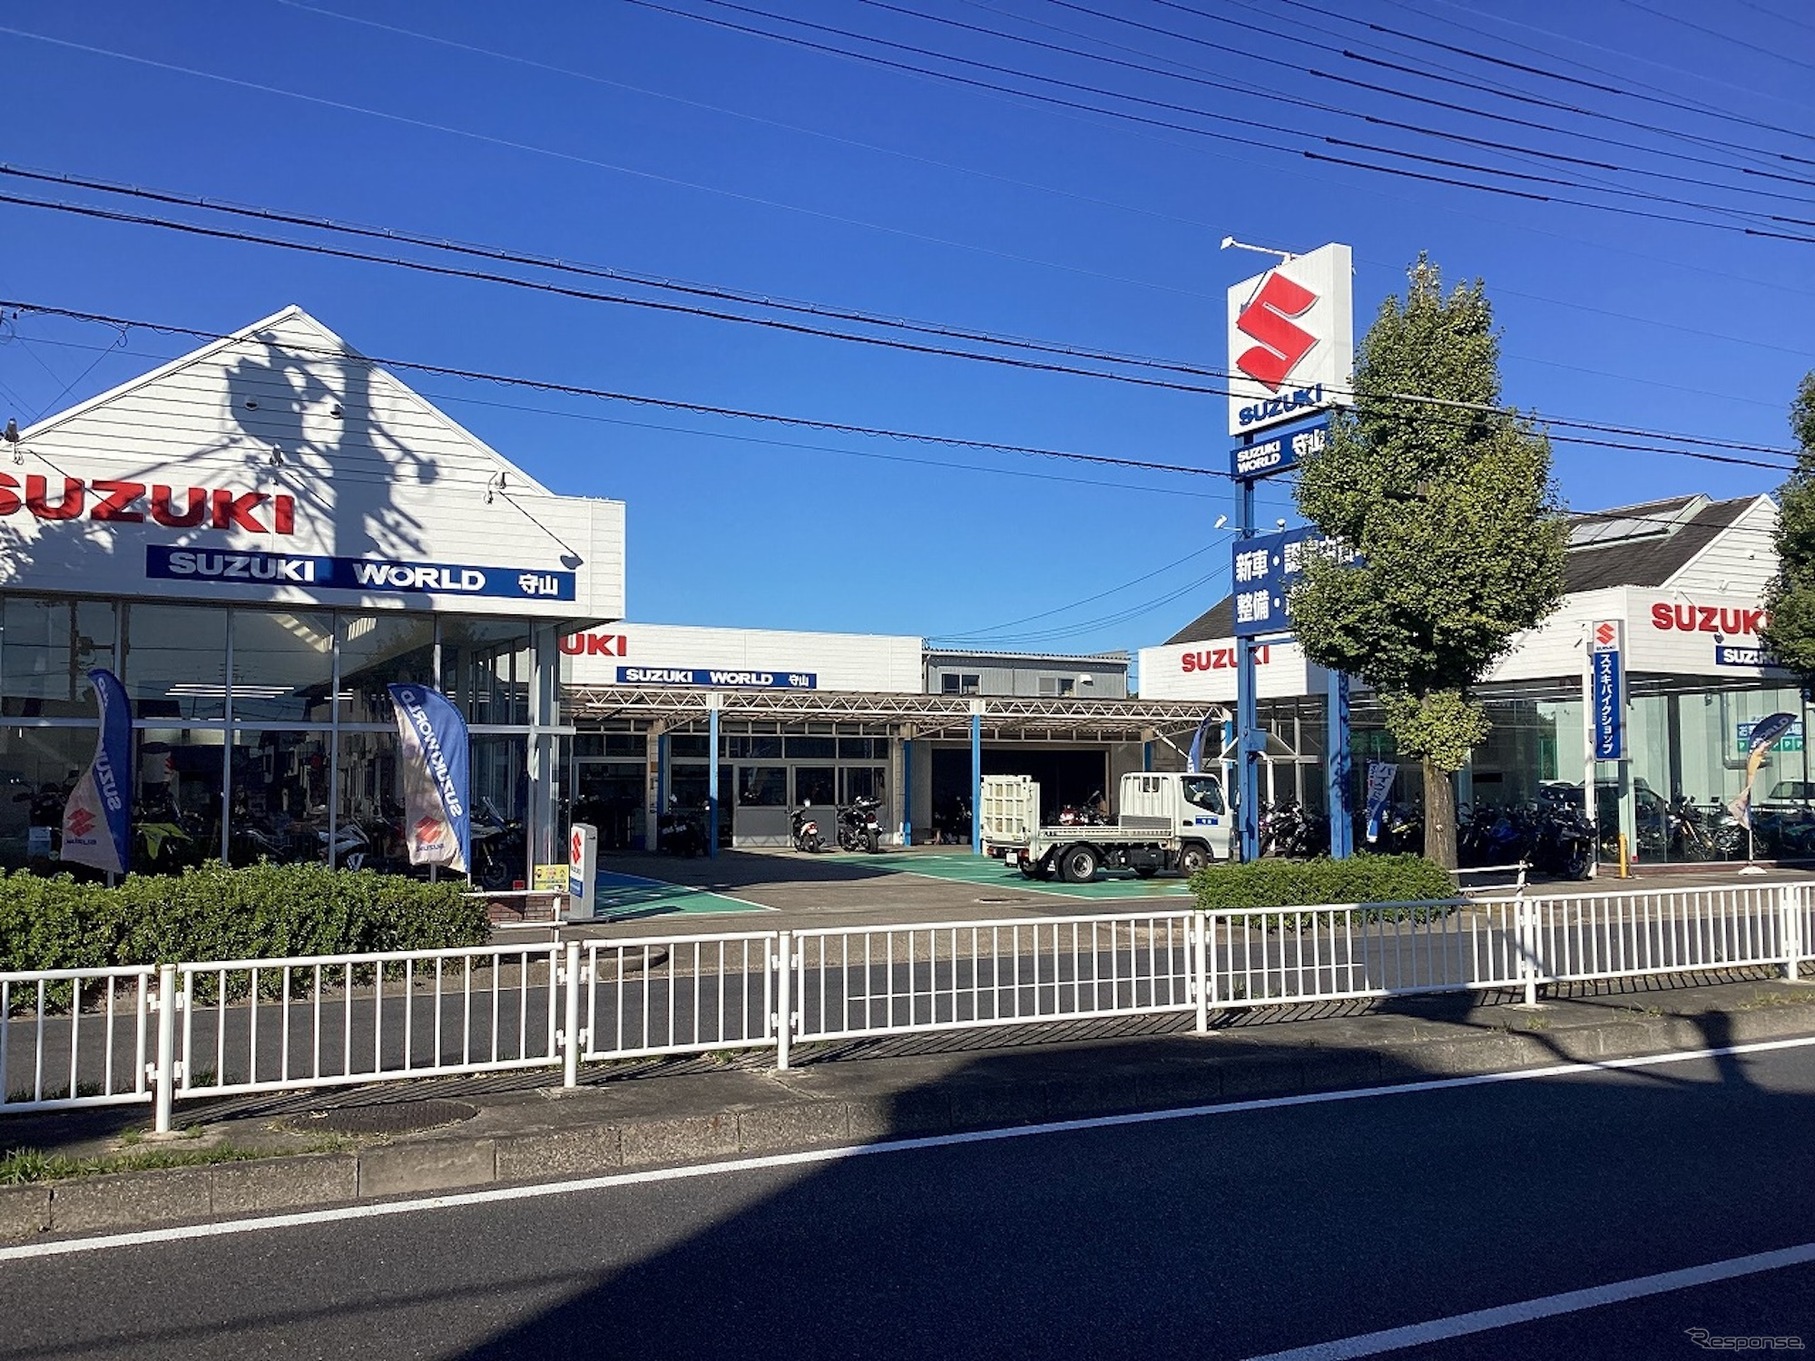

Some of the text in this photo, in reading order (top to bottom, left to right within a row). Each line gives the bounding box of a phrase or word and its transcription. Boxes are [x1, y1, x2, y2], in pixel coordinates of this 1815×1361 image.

[1239, 383, 1322, 425] SUZUKI
[1237, 441, 1280, 461] SUZUKI
[1237, 453, 1281, 473] WORLD
[169, 552, 559, 595] SUZUKI WORLD 守山
[626, 669, 693, 683] SUZUKI
[709, 672, 773, 685] WORLD
[1600, 654, 1614, 755] スズキバイクショップ
